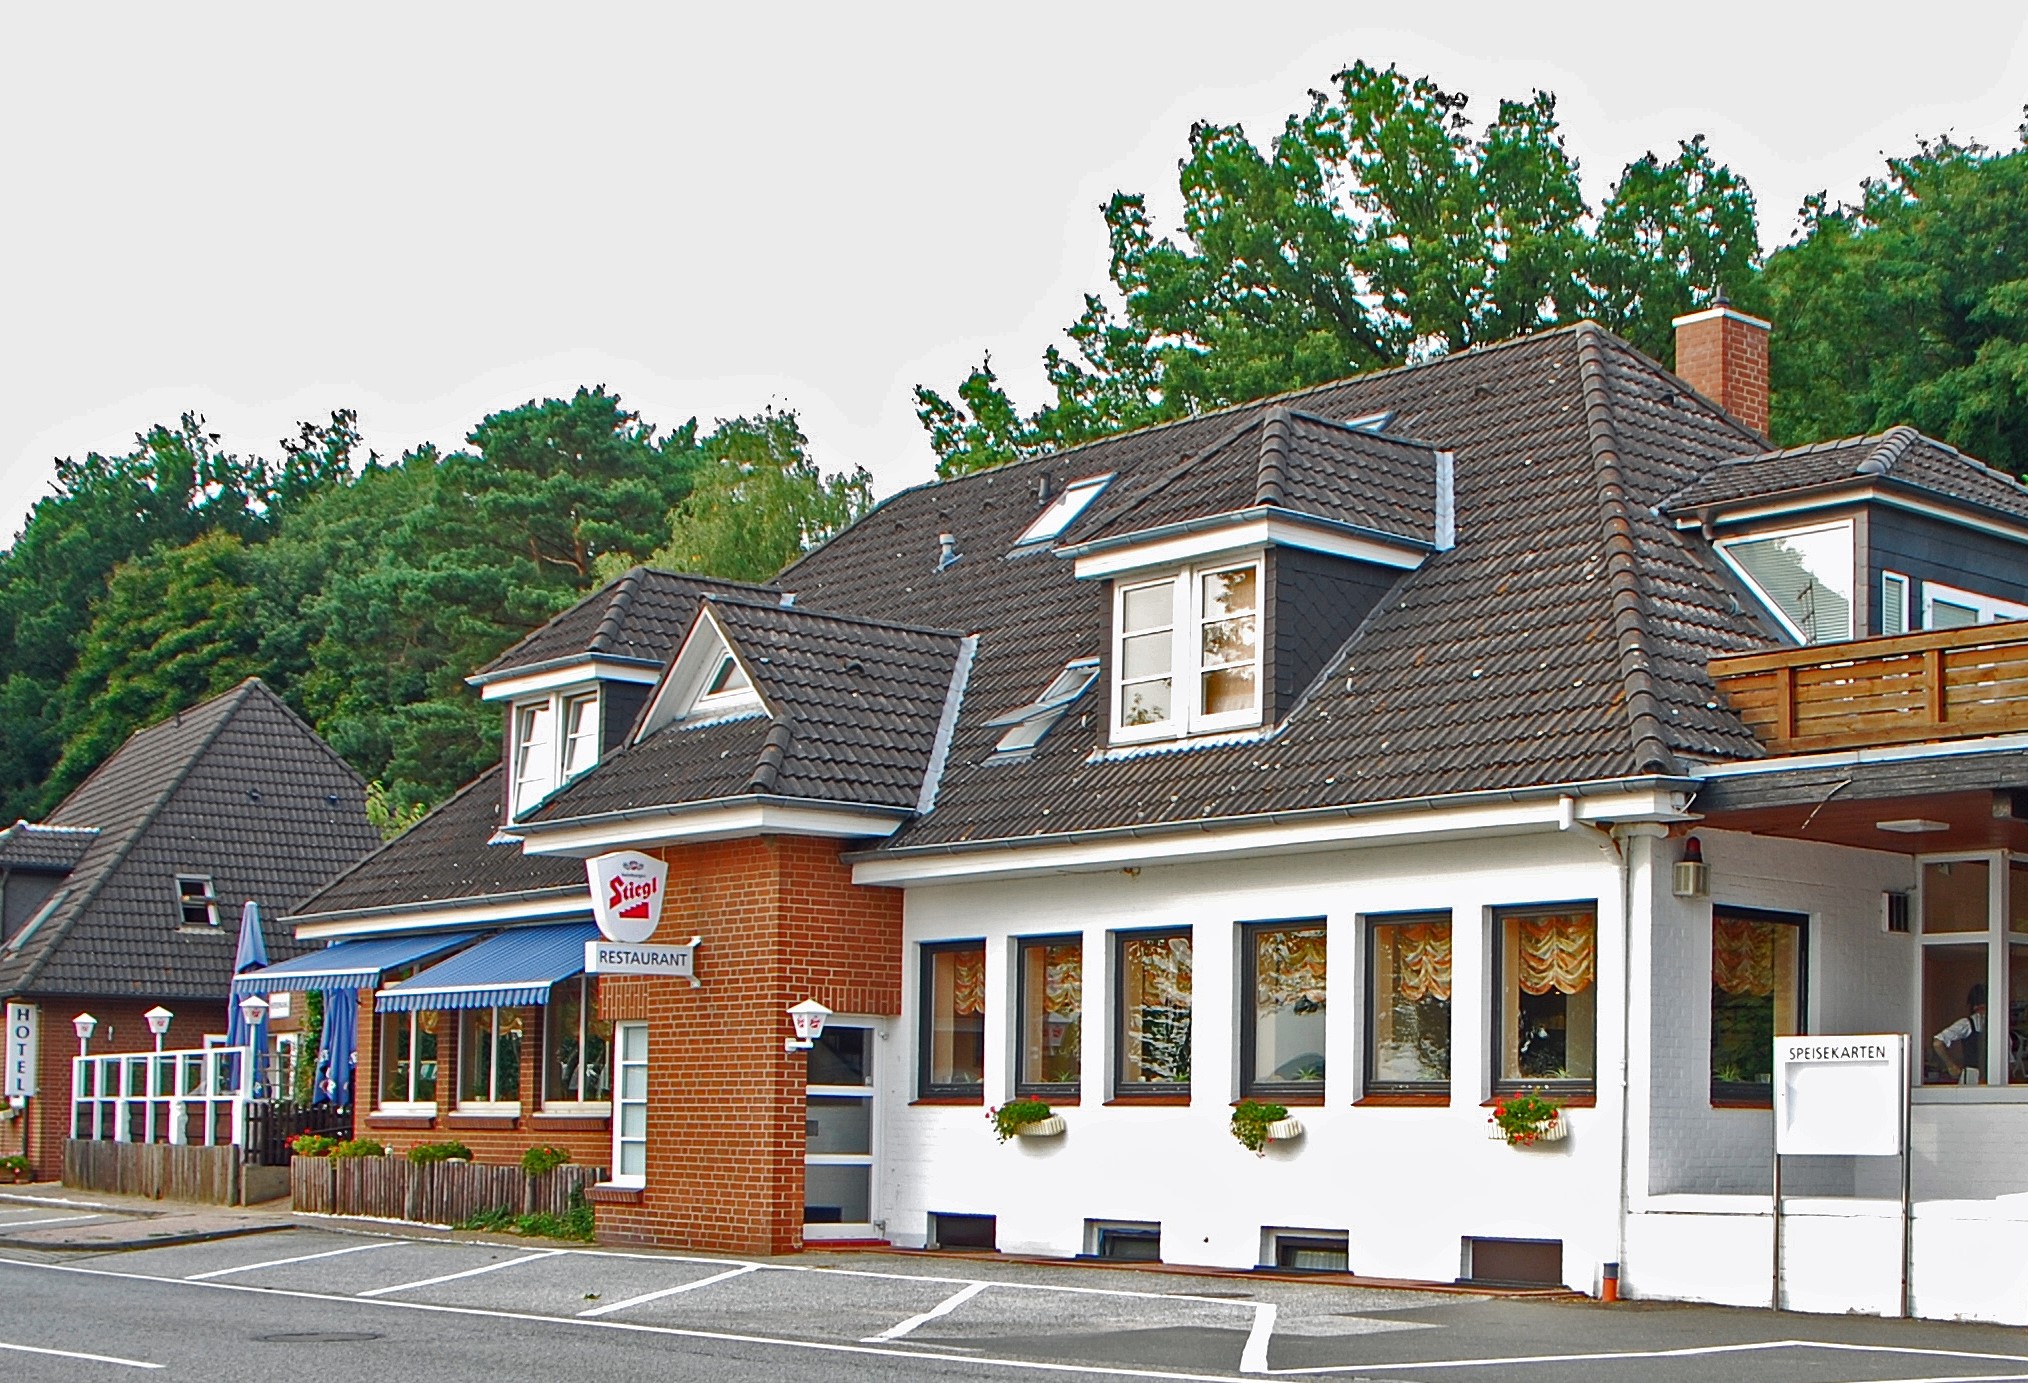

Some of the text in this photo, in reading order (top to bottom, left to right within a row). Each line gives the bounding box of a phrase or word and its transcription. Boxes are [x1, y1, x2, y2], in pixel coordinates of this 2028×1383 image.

[609, 875, 657, 909] Stiegl
[599, 950, 688, 967] RESTAURANT
[15, 1008, 31, 1091] HOTEL
[1789, 1046, 1886, 1060] SPEISEKARTEN
